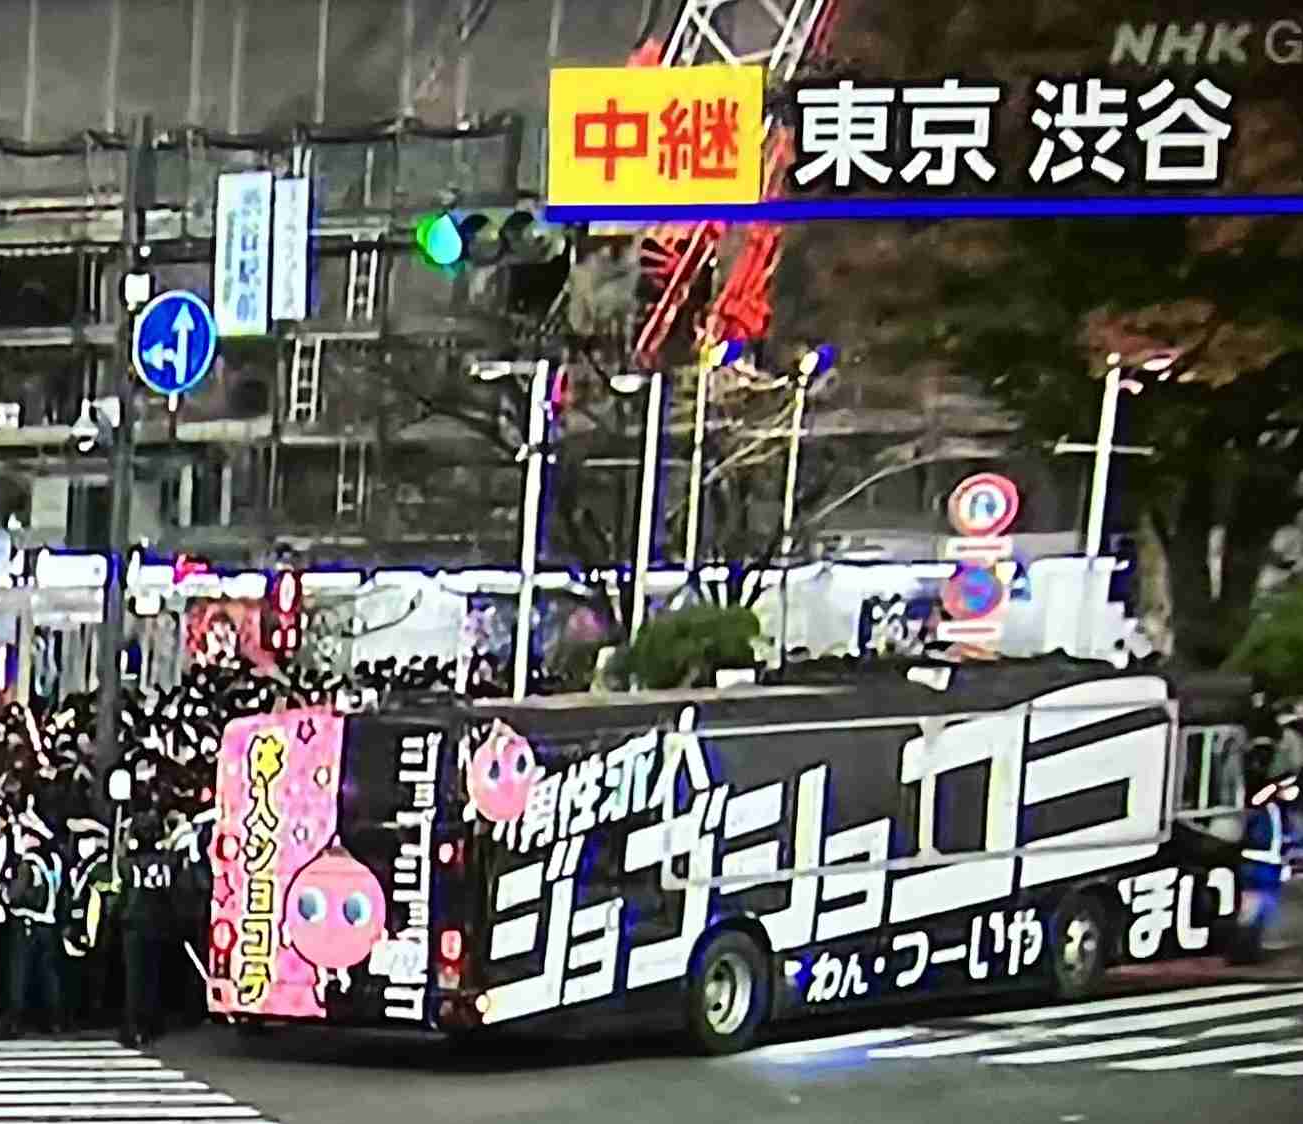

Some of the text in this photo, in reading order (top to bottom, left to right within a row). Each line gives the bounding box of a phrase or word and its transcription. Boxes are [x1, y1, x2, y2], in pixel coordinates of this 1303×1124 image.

[1109, 19, 1303, 66] NHK G
[573, 97, 740, 181] 中継
[794, 78, 1233, 187] 東京 渋谷
[519, 706, 710, 853] 男性求人
